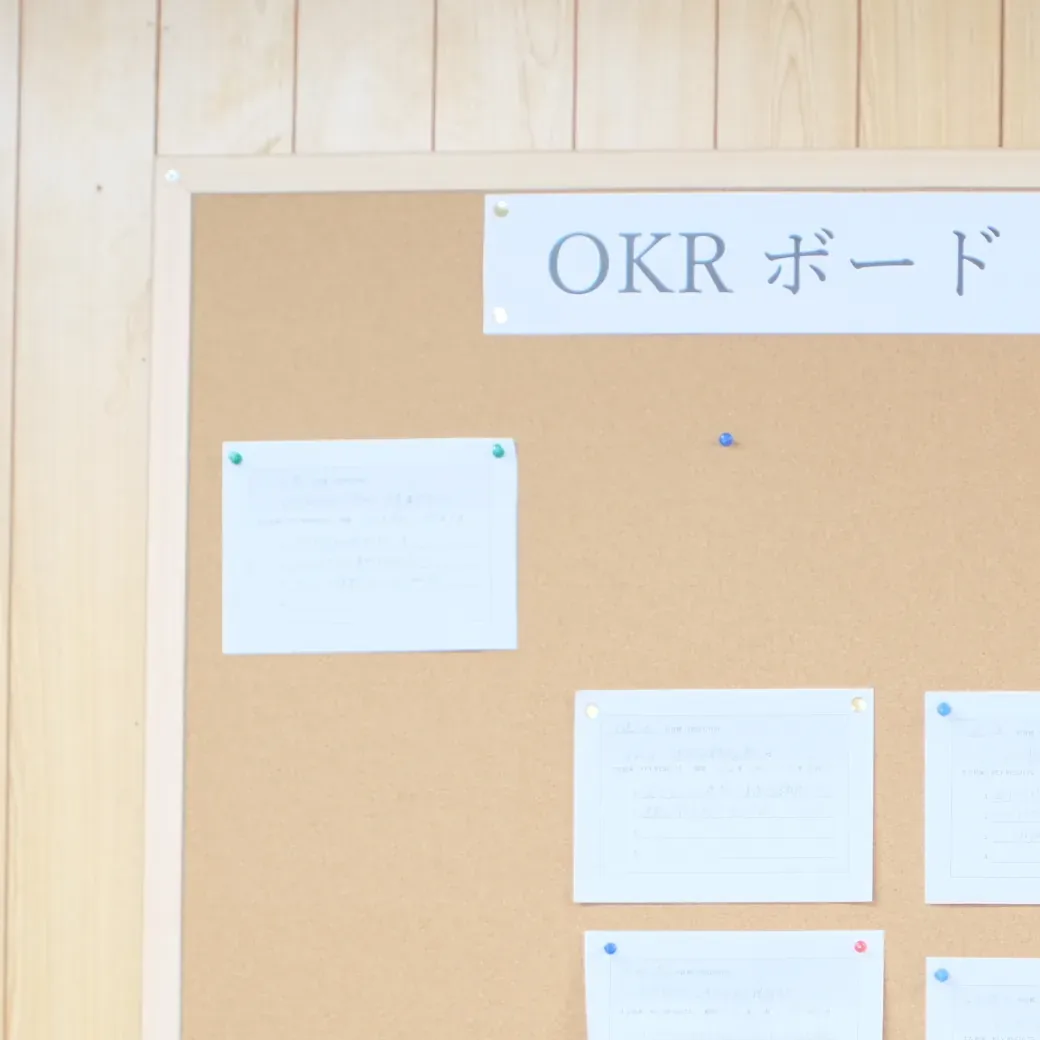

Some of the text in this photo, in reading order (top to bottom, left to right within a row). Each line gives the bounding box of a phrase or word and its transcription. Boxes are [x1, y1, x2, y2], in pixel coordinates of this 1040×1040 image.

[548, 226, 1001, 296] OKR ボード
